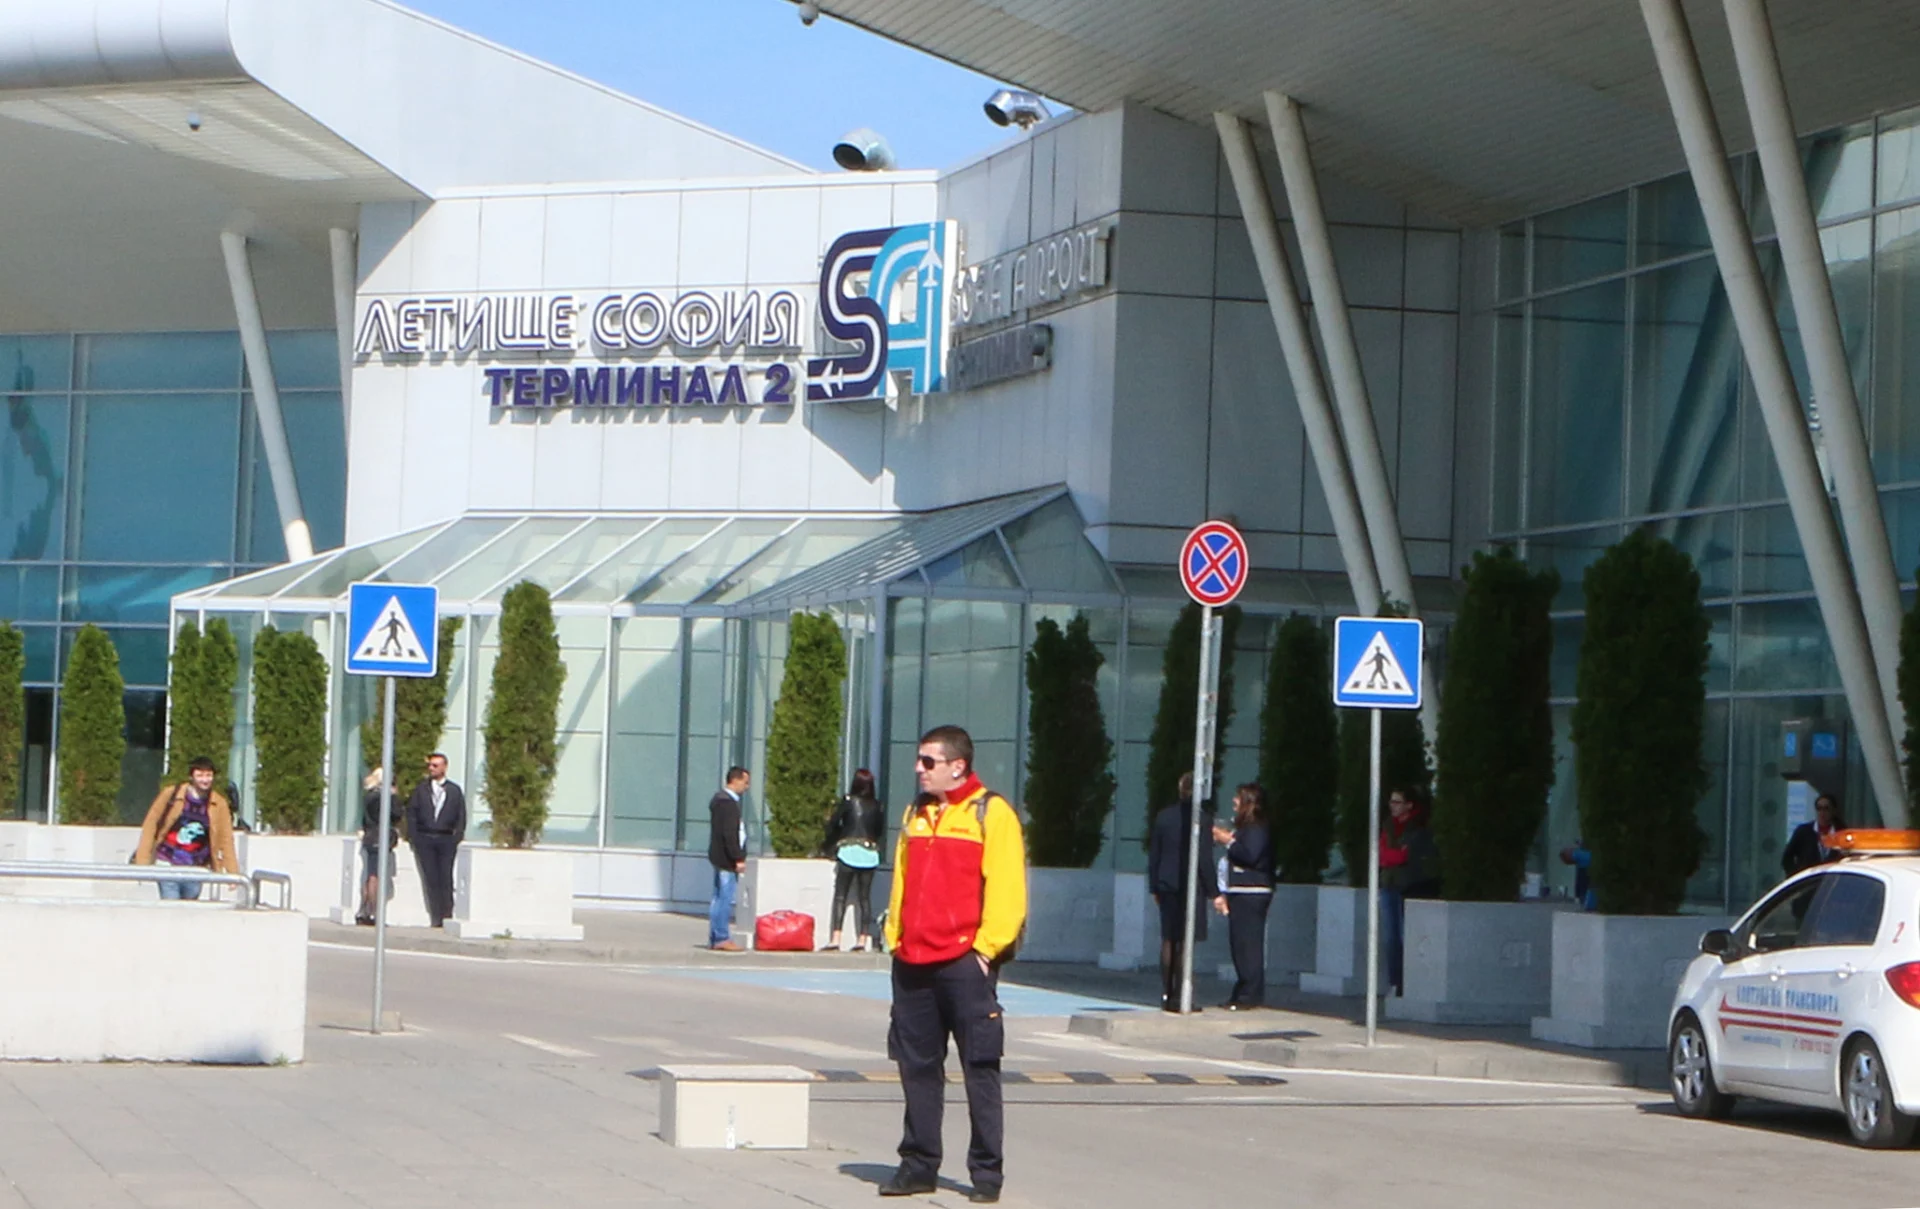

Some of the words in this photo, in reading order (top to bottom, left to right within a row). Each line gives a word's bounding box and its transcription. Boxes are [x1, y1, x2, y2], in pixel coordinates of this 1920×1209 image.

[1014, 227, 1098, 312] AIRPORT
[356, 296, 579, 353] ЛЕТИЩЕ
[592, 289, 803, 350] СОФИЯ
[484, 364, 748, 406] ТЕРМИНАЛ
[763, 363, 792, 404] 2
